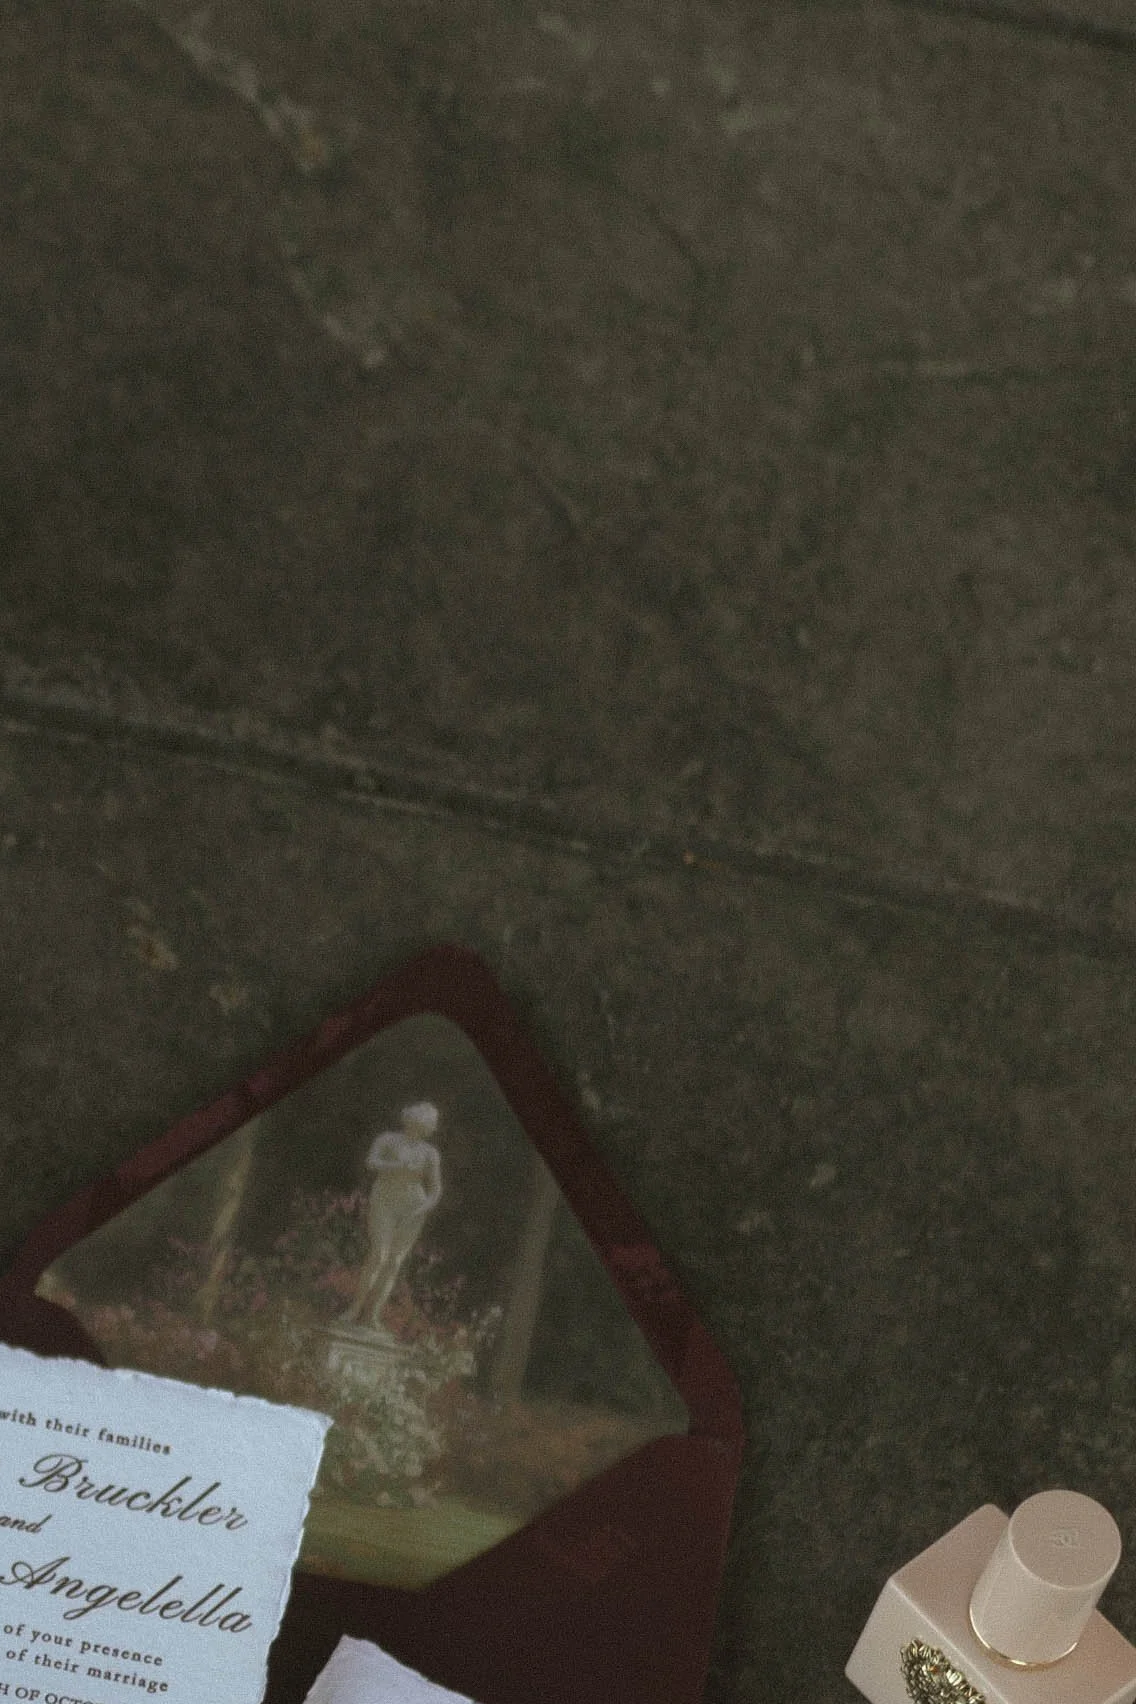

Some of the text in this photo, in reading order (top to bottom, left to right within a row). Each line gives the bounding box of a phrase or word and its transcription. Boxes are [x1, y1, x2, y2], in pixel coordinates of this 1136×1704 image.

[45, 1417, 90, 1438] their
[98, 1427, 171, 1456] families
[17, 1453, 248, 1531] Bruckler
[3, 1623, 26, 1637] of
[30, 1630, 73, 1647] your
[79, 1641, 163, 1666] presence
[6, 1648, 28, 1662] of
[34, 1653, 80, 1673] their
[86, 1667, 168, 1694] marriage
[15, 1686, 41, 1701] OF
